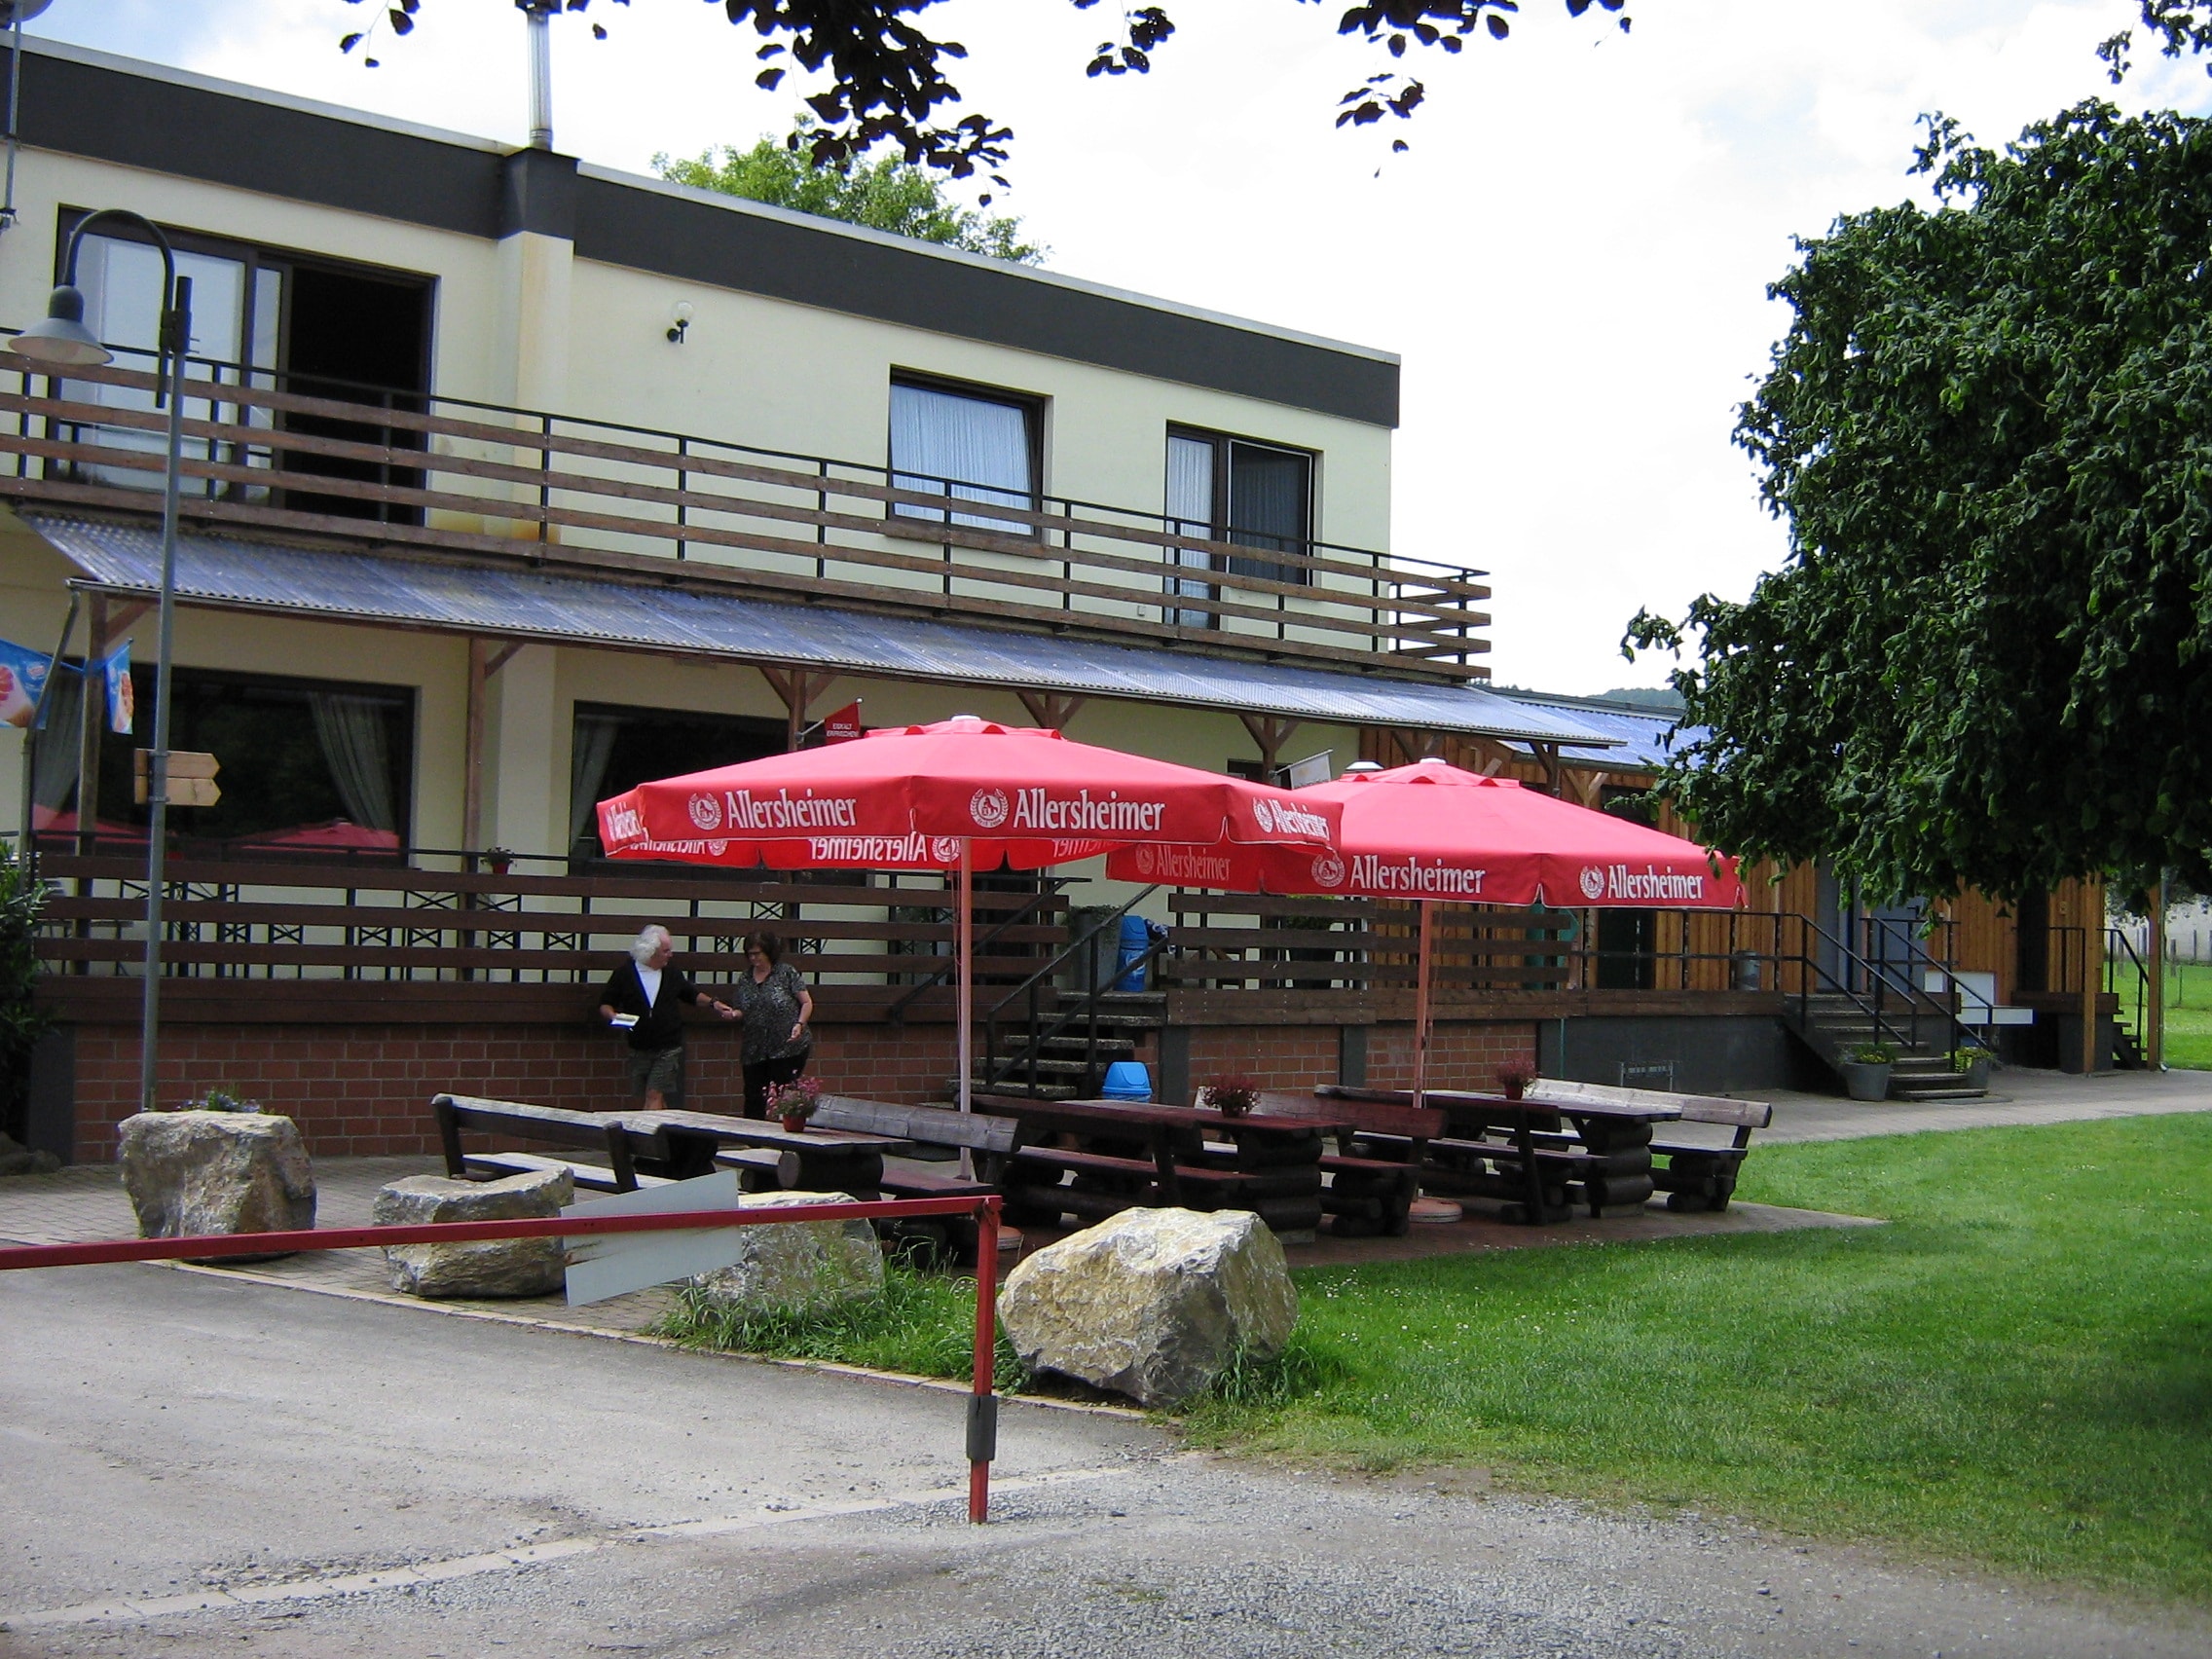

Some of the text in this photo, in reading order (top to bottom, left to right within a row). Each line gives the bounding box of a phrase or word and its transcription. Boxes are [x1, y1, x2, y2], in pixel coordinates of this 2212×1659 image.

[725, 789, 857, 829] Allersheimer
[1014, 788, 1165, 830] Allersheimer
[1156, 844, 1232, 881] Allersheimer
[1349, 855, 1486, 893] Allersheimer
[1607, 865, 1703, 899] Allersheimer
